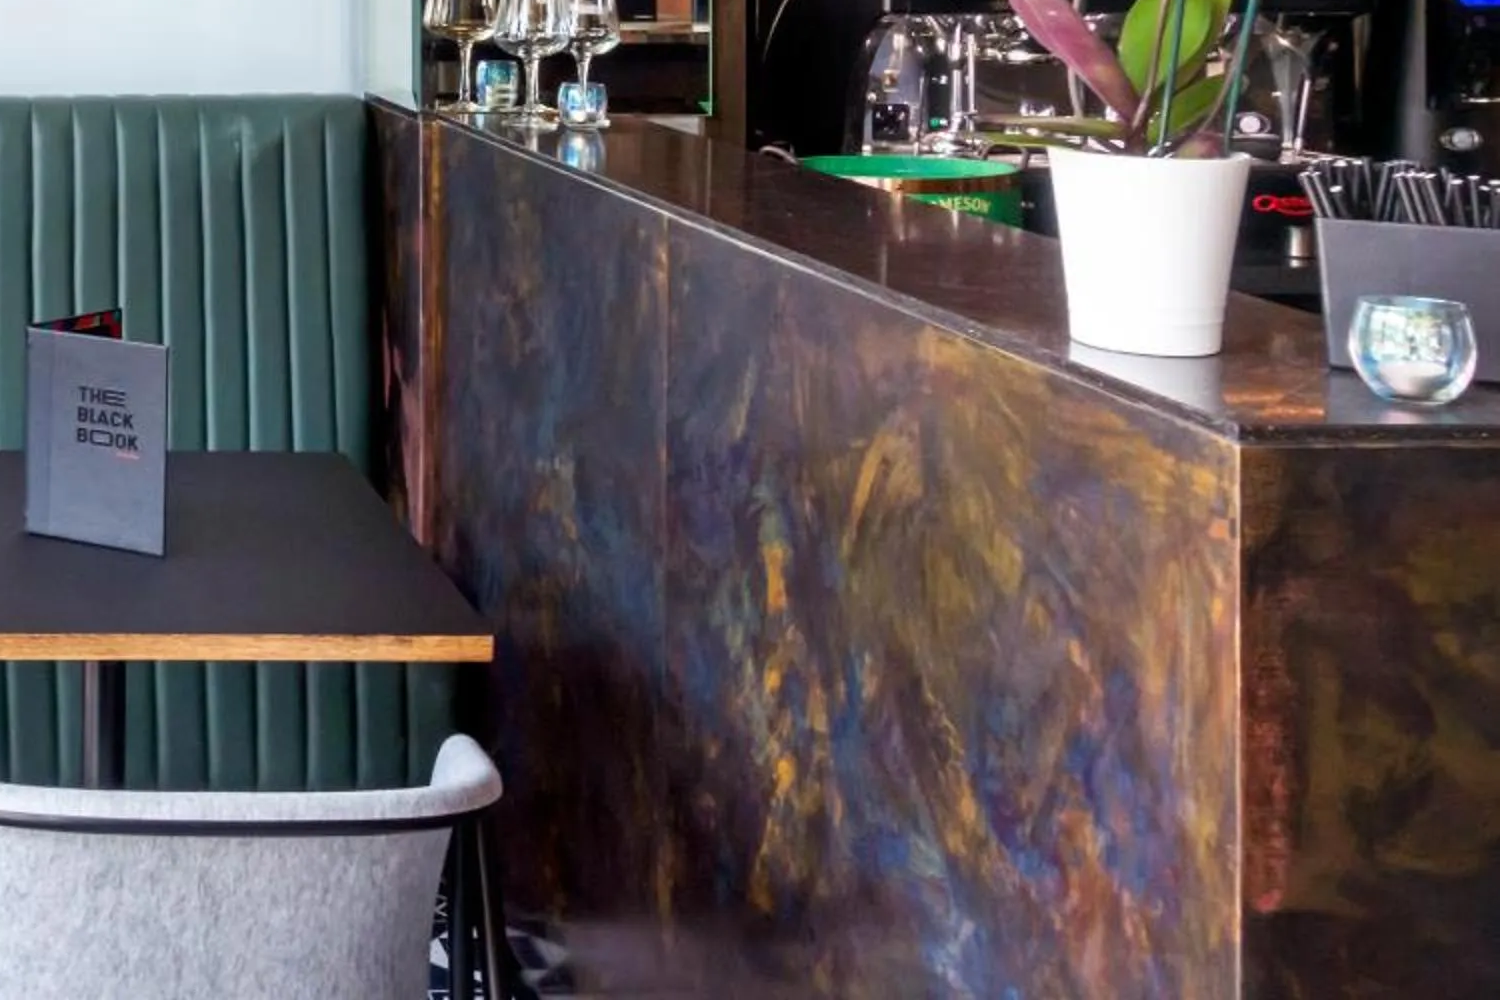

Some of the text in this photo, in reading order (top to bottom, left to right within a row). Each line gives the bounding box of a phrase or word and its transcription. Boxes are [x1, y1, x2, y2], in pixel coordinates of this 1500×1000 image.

[77, 386, 127, 407] THE
[77, 406, 135, 430] BLACK
[76, 427, 139, 451] BOOK
